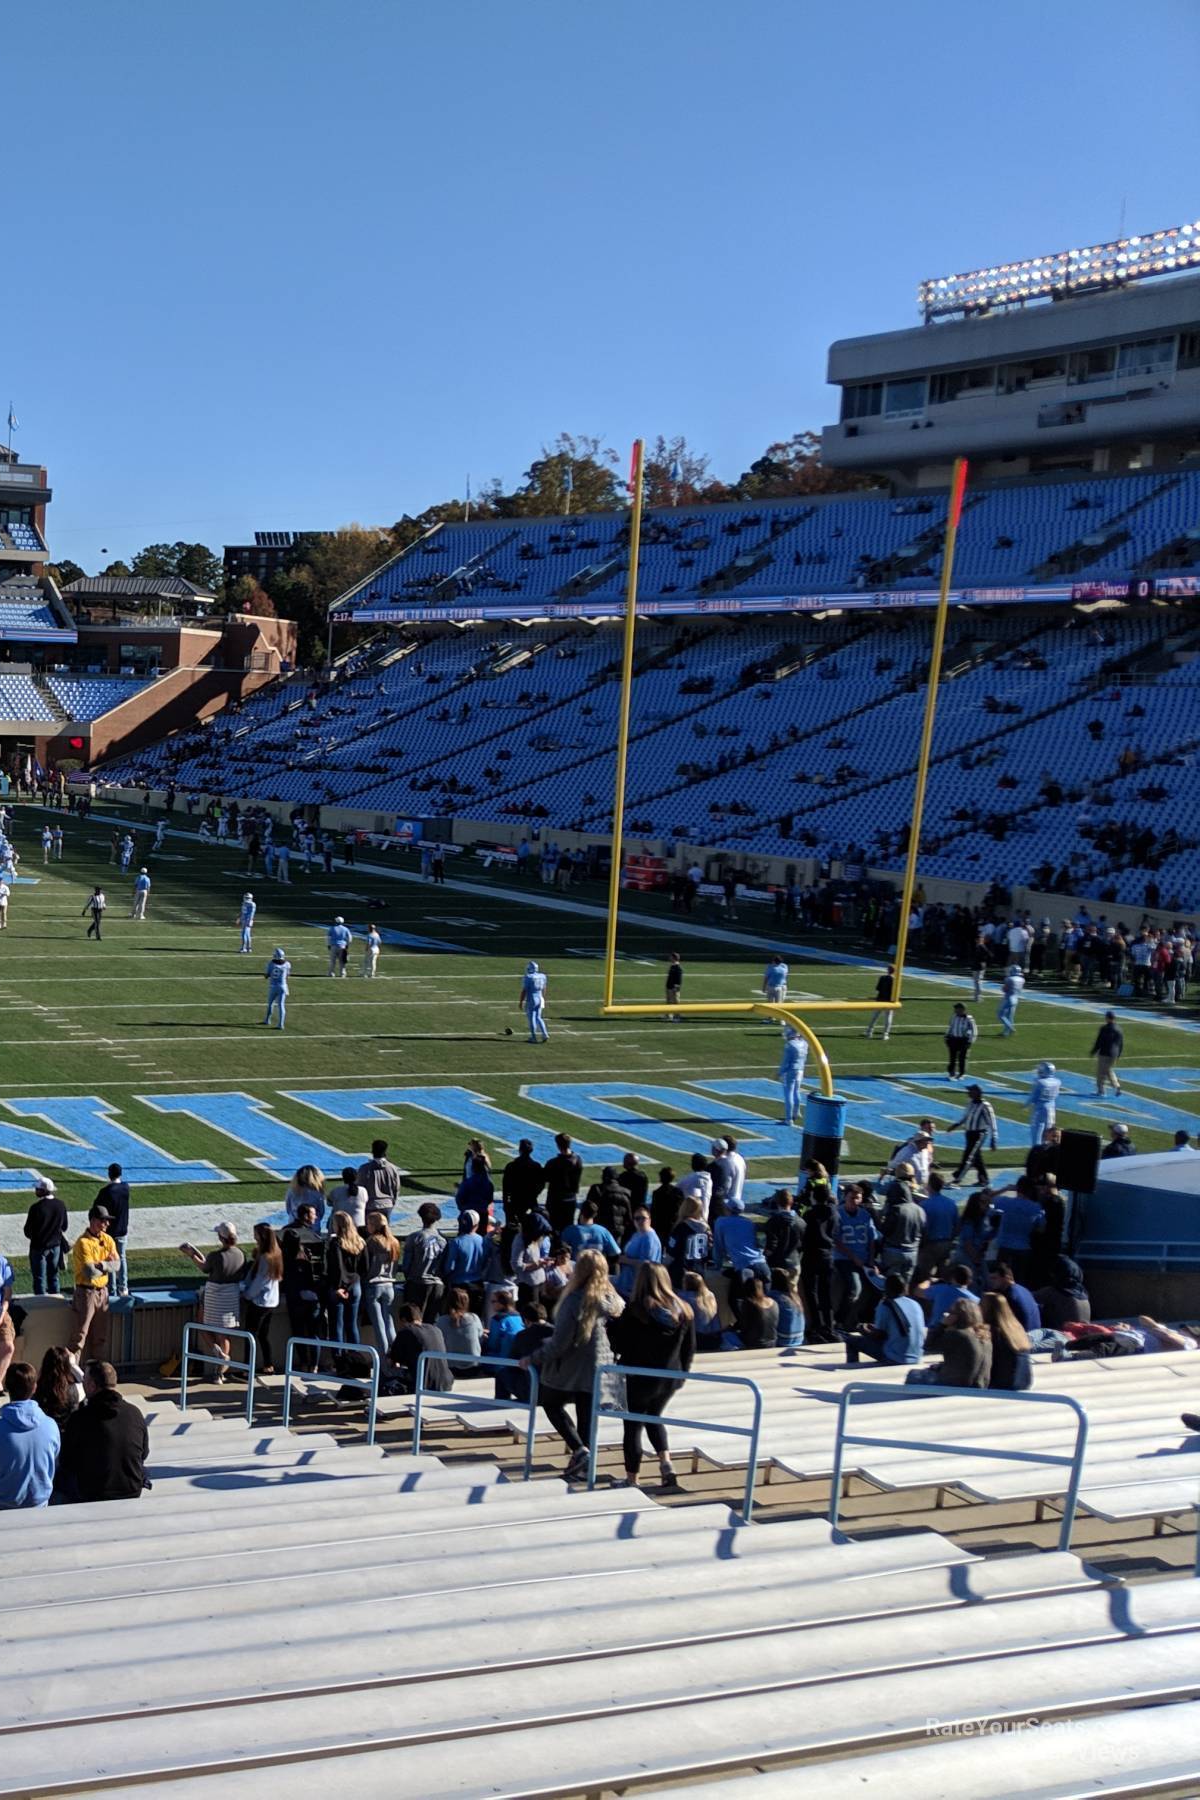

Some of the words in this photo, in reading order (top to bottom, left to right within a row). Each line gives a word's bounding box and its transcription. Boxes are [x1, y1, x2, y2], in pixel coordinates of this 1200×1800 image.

[1138, 582, 1148, 596] 0
[796, 597, 825, 608] JONES
[333, 612, 348, 622] 2:17
[374, 610, 408, 621] WELCOME
[411, 610, 420, 620] TO
[449, 608, 484, 620] STADIUM
[841, 1225, 868, 1244] 23
